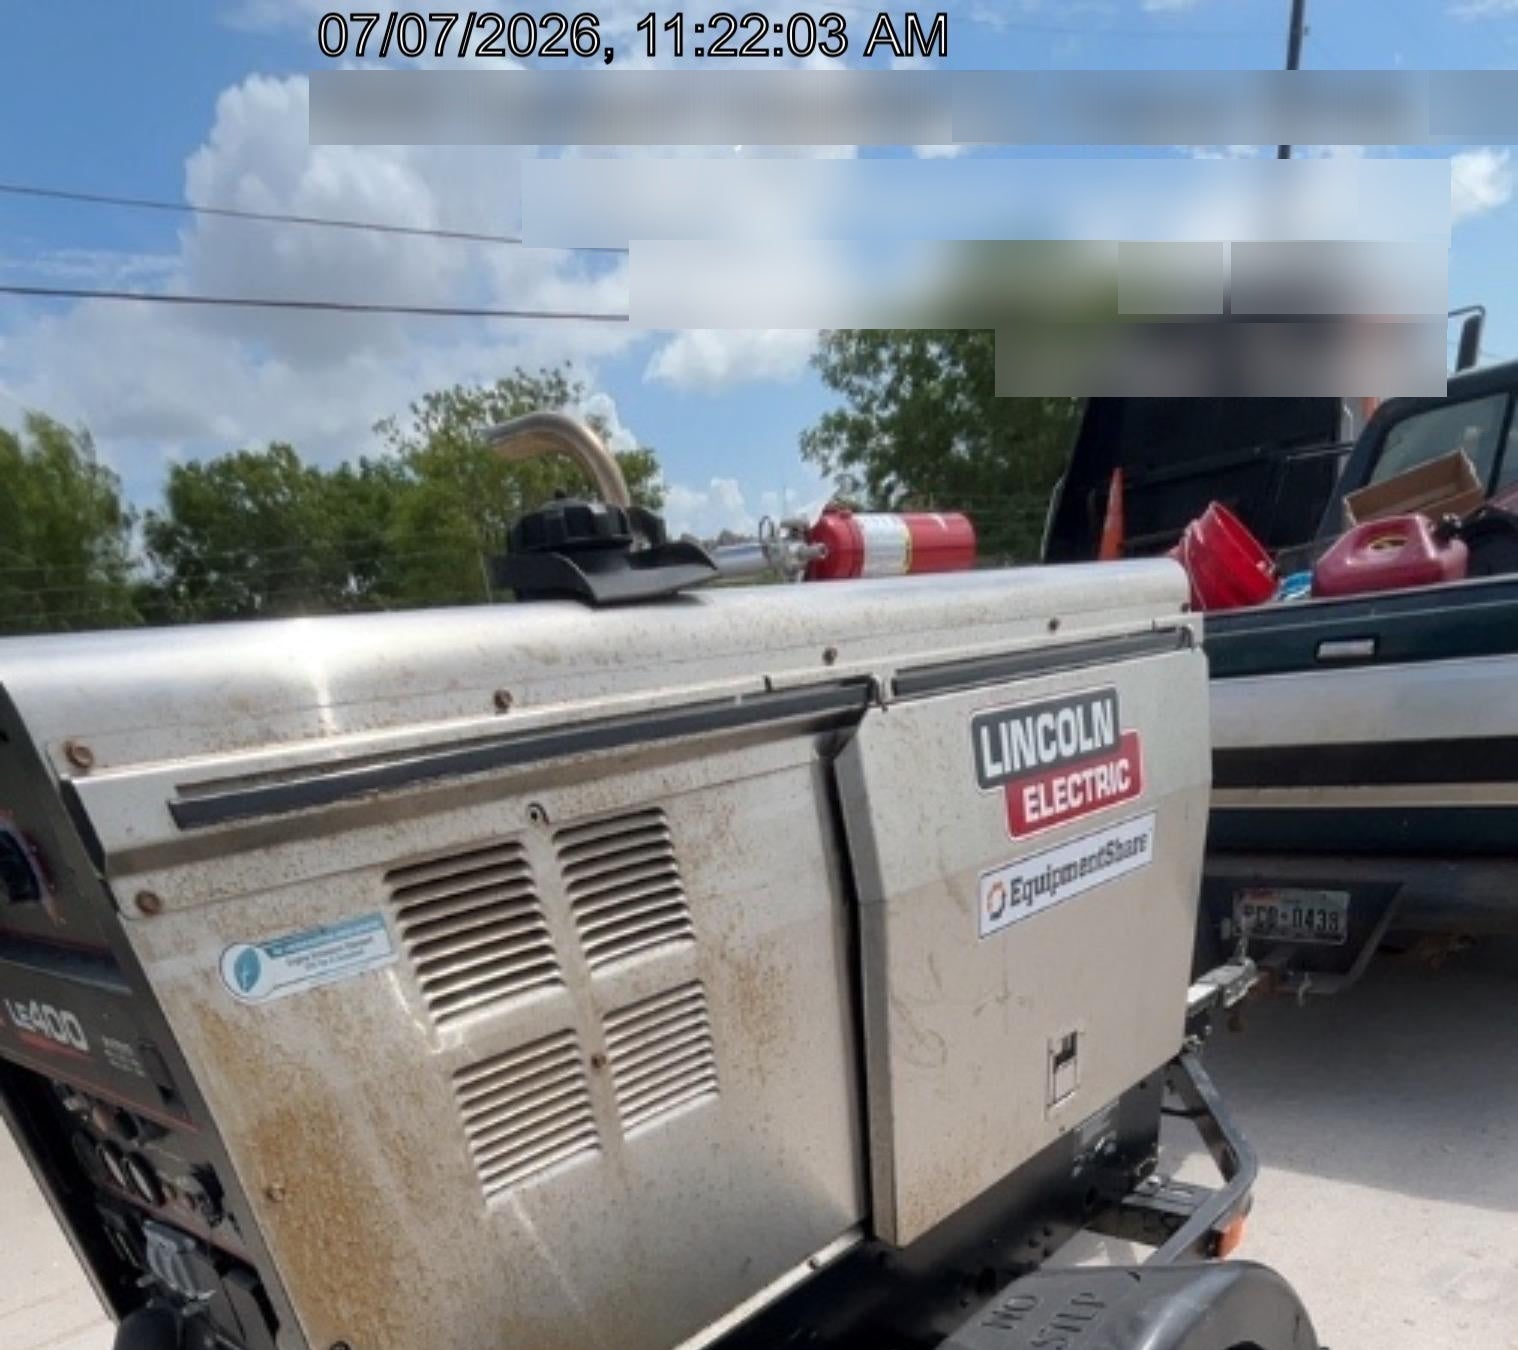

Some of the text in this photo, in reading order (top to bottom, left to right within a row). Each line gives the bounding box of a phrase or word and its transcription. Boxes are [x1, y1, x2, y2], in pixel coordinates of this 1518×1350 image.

[980, 699, 1114, 778] LINCOLN
[1022, 758, 1131, 823] ELECTRIC
[1010, 832, 1148, 907] EquipmentShare
